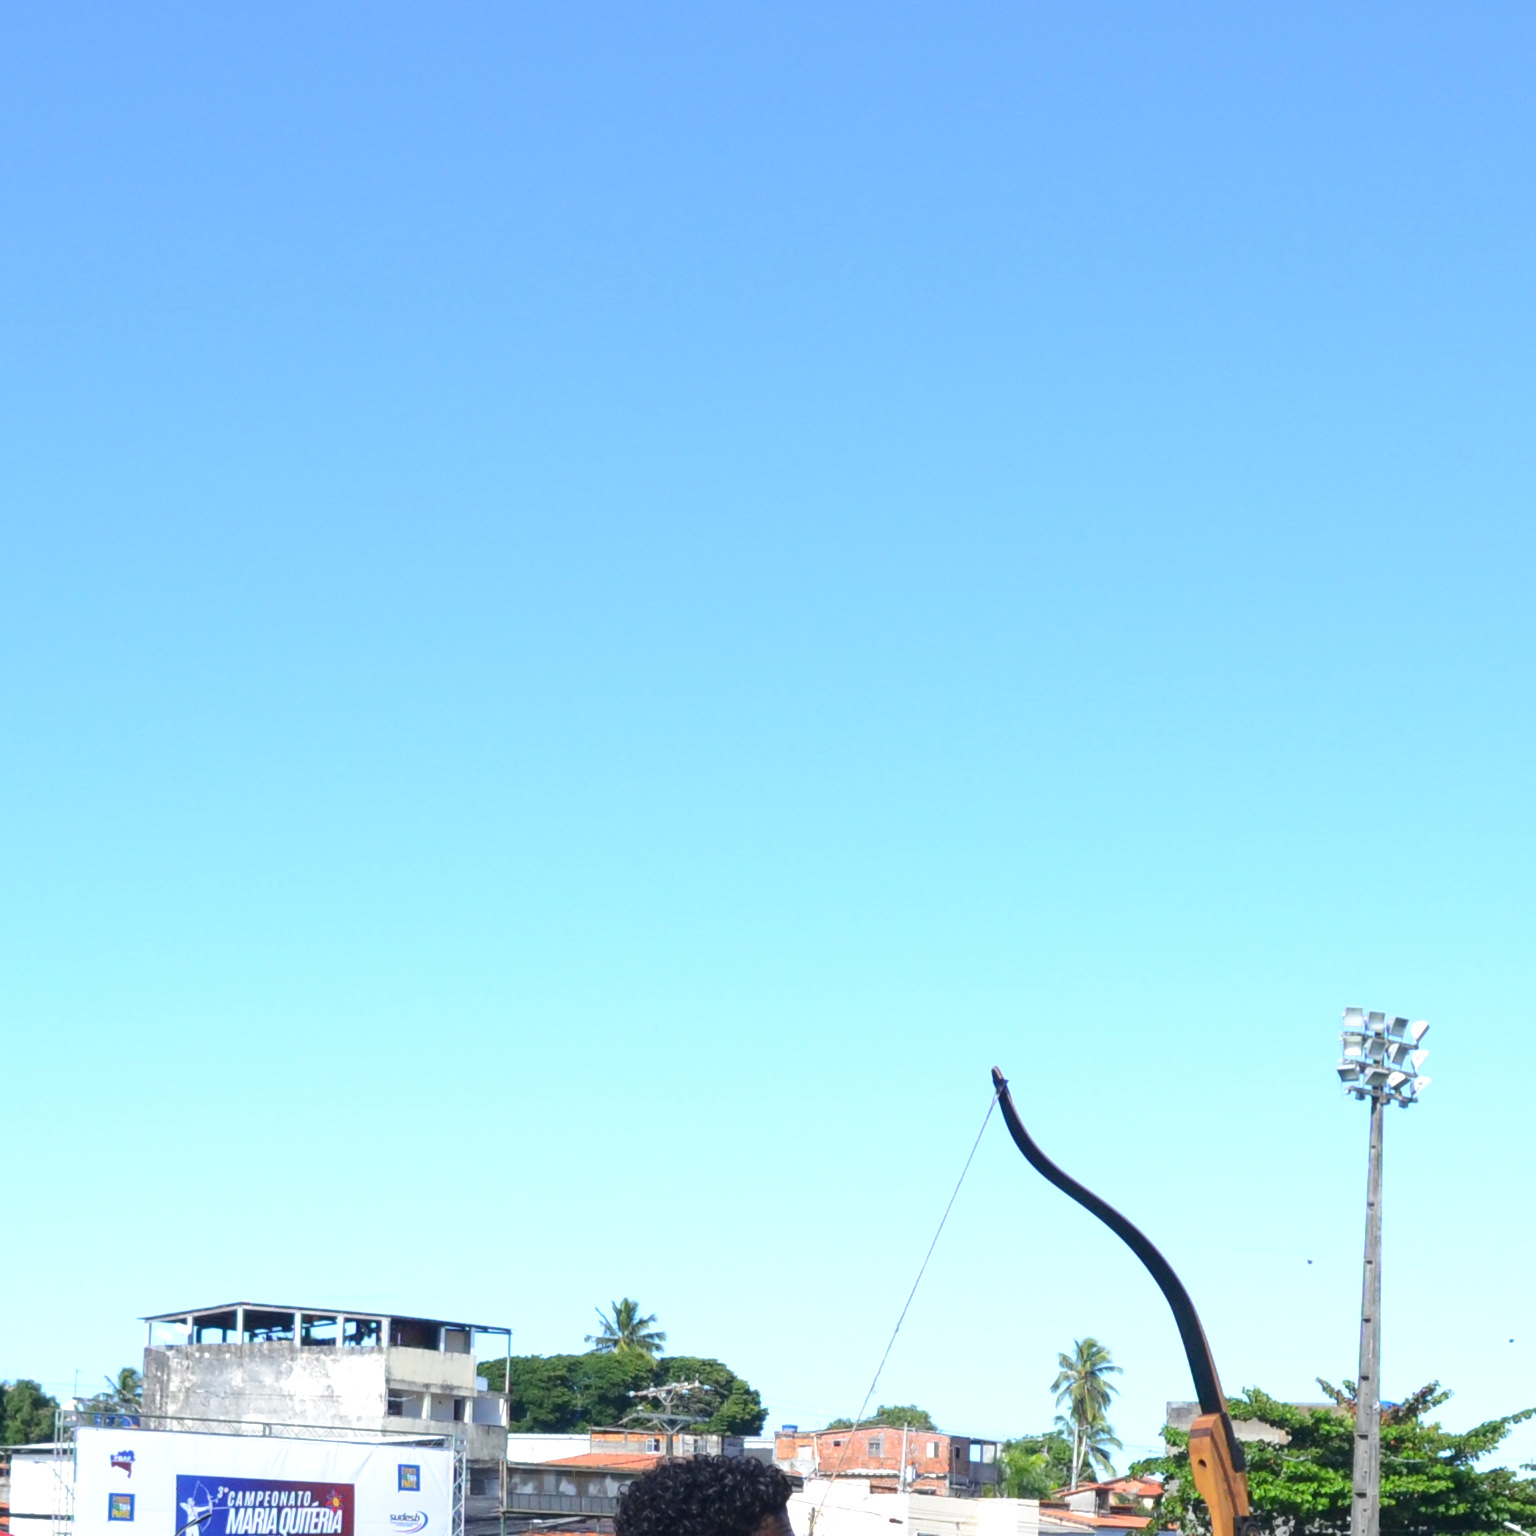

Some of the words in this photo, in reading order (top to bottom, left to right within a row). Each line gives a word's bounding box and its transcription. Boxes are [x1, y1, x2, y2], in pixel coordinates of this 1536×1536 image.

[227, 1490, 312, 1507] CAMPEONATO
[225, 1507, 278, 1535] MARIA
[279, 1501, 343, 1536] QUITÉRIA
[390, 1512, 421, 1522] sudesb
